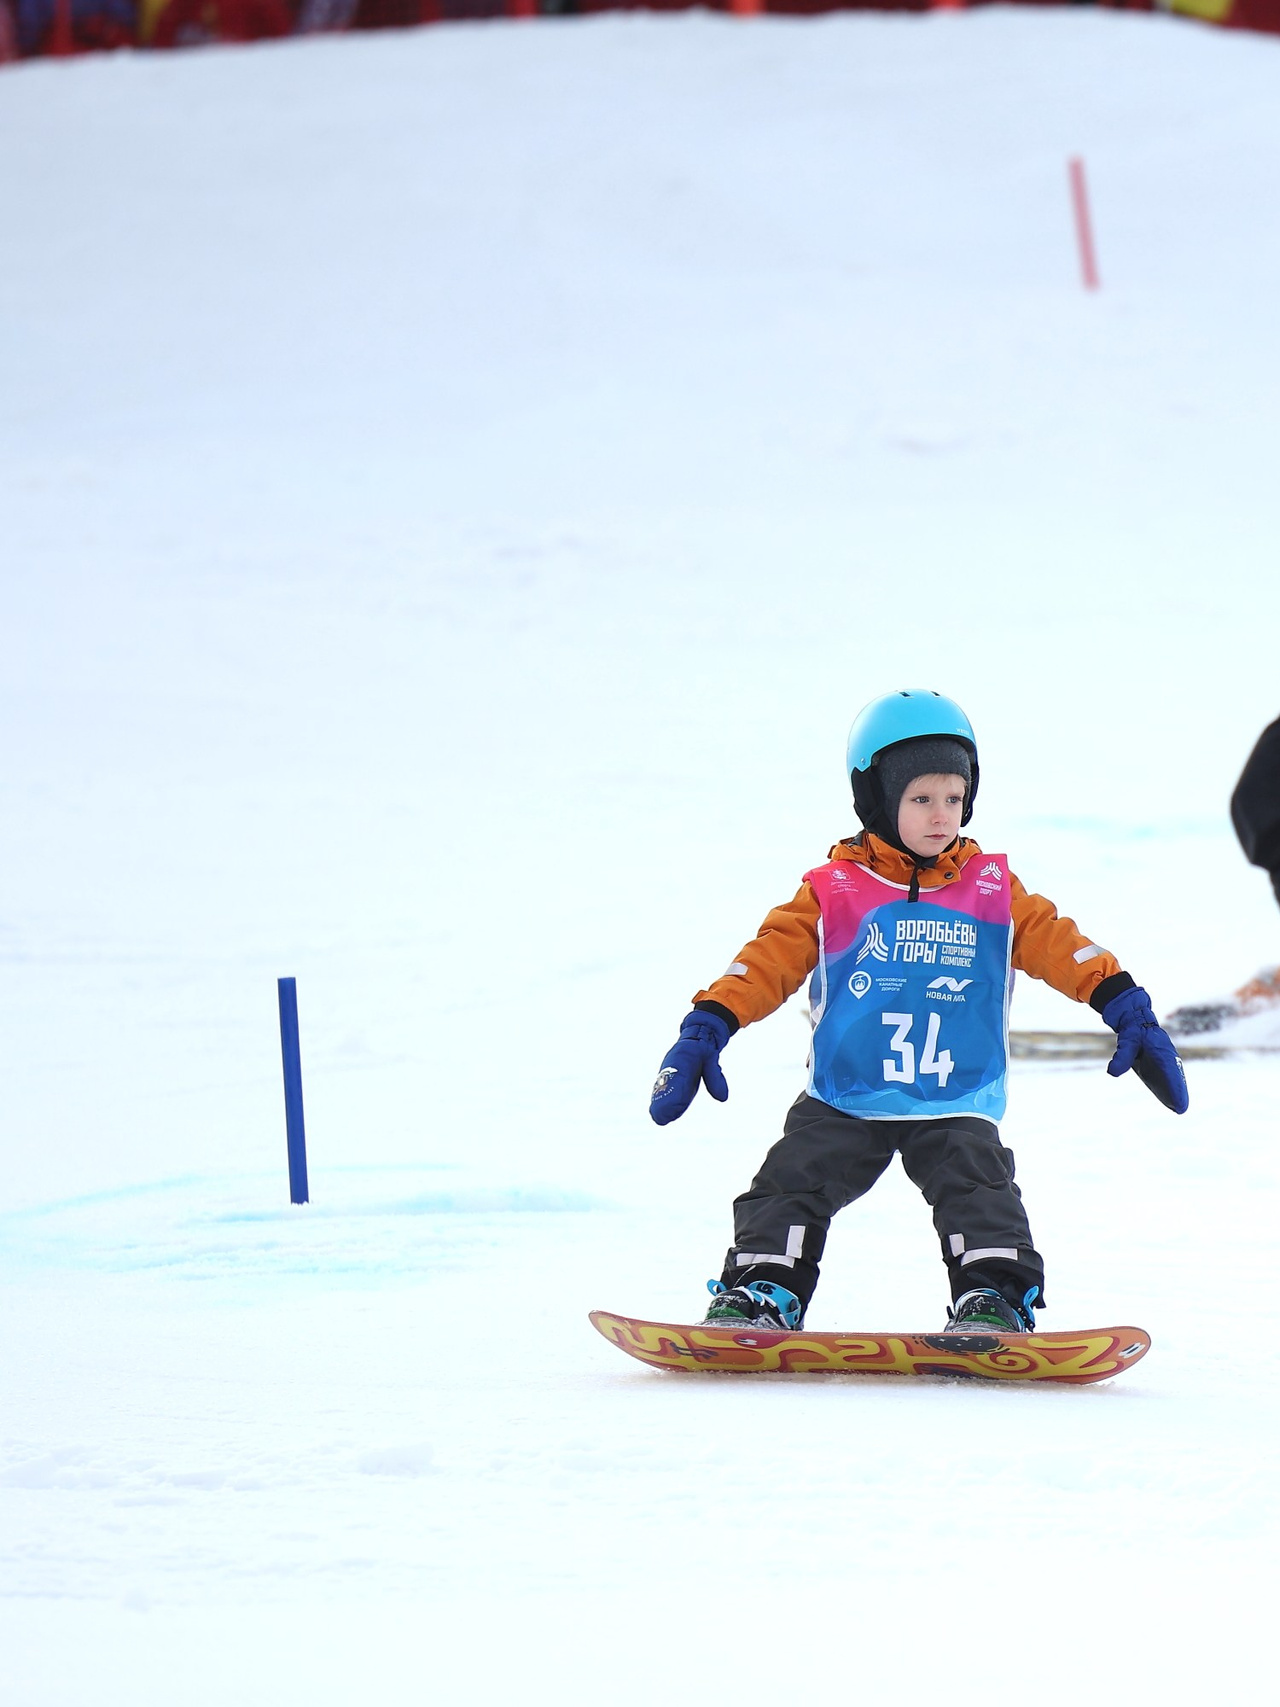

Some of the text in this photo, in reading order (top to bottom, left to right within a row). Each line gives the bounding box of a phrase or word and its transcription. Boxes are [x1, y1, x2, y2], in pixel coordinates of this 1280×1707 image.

[896, 919, 977, 946] ВОРОБЬЁВЫ
[892, 941, 938, 964] ГОРЫ
[941, 945, 976, 958] СПОРТИВНЫ
[940, 955, 972, 968] КОМПЛЕКС
[925, 990, 952, 1002] НОВАЯ
[881, 1012, 955, 1088] 34
